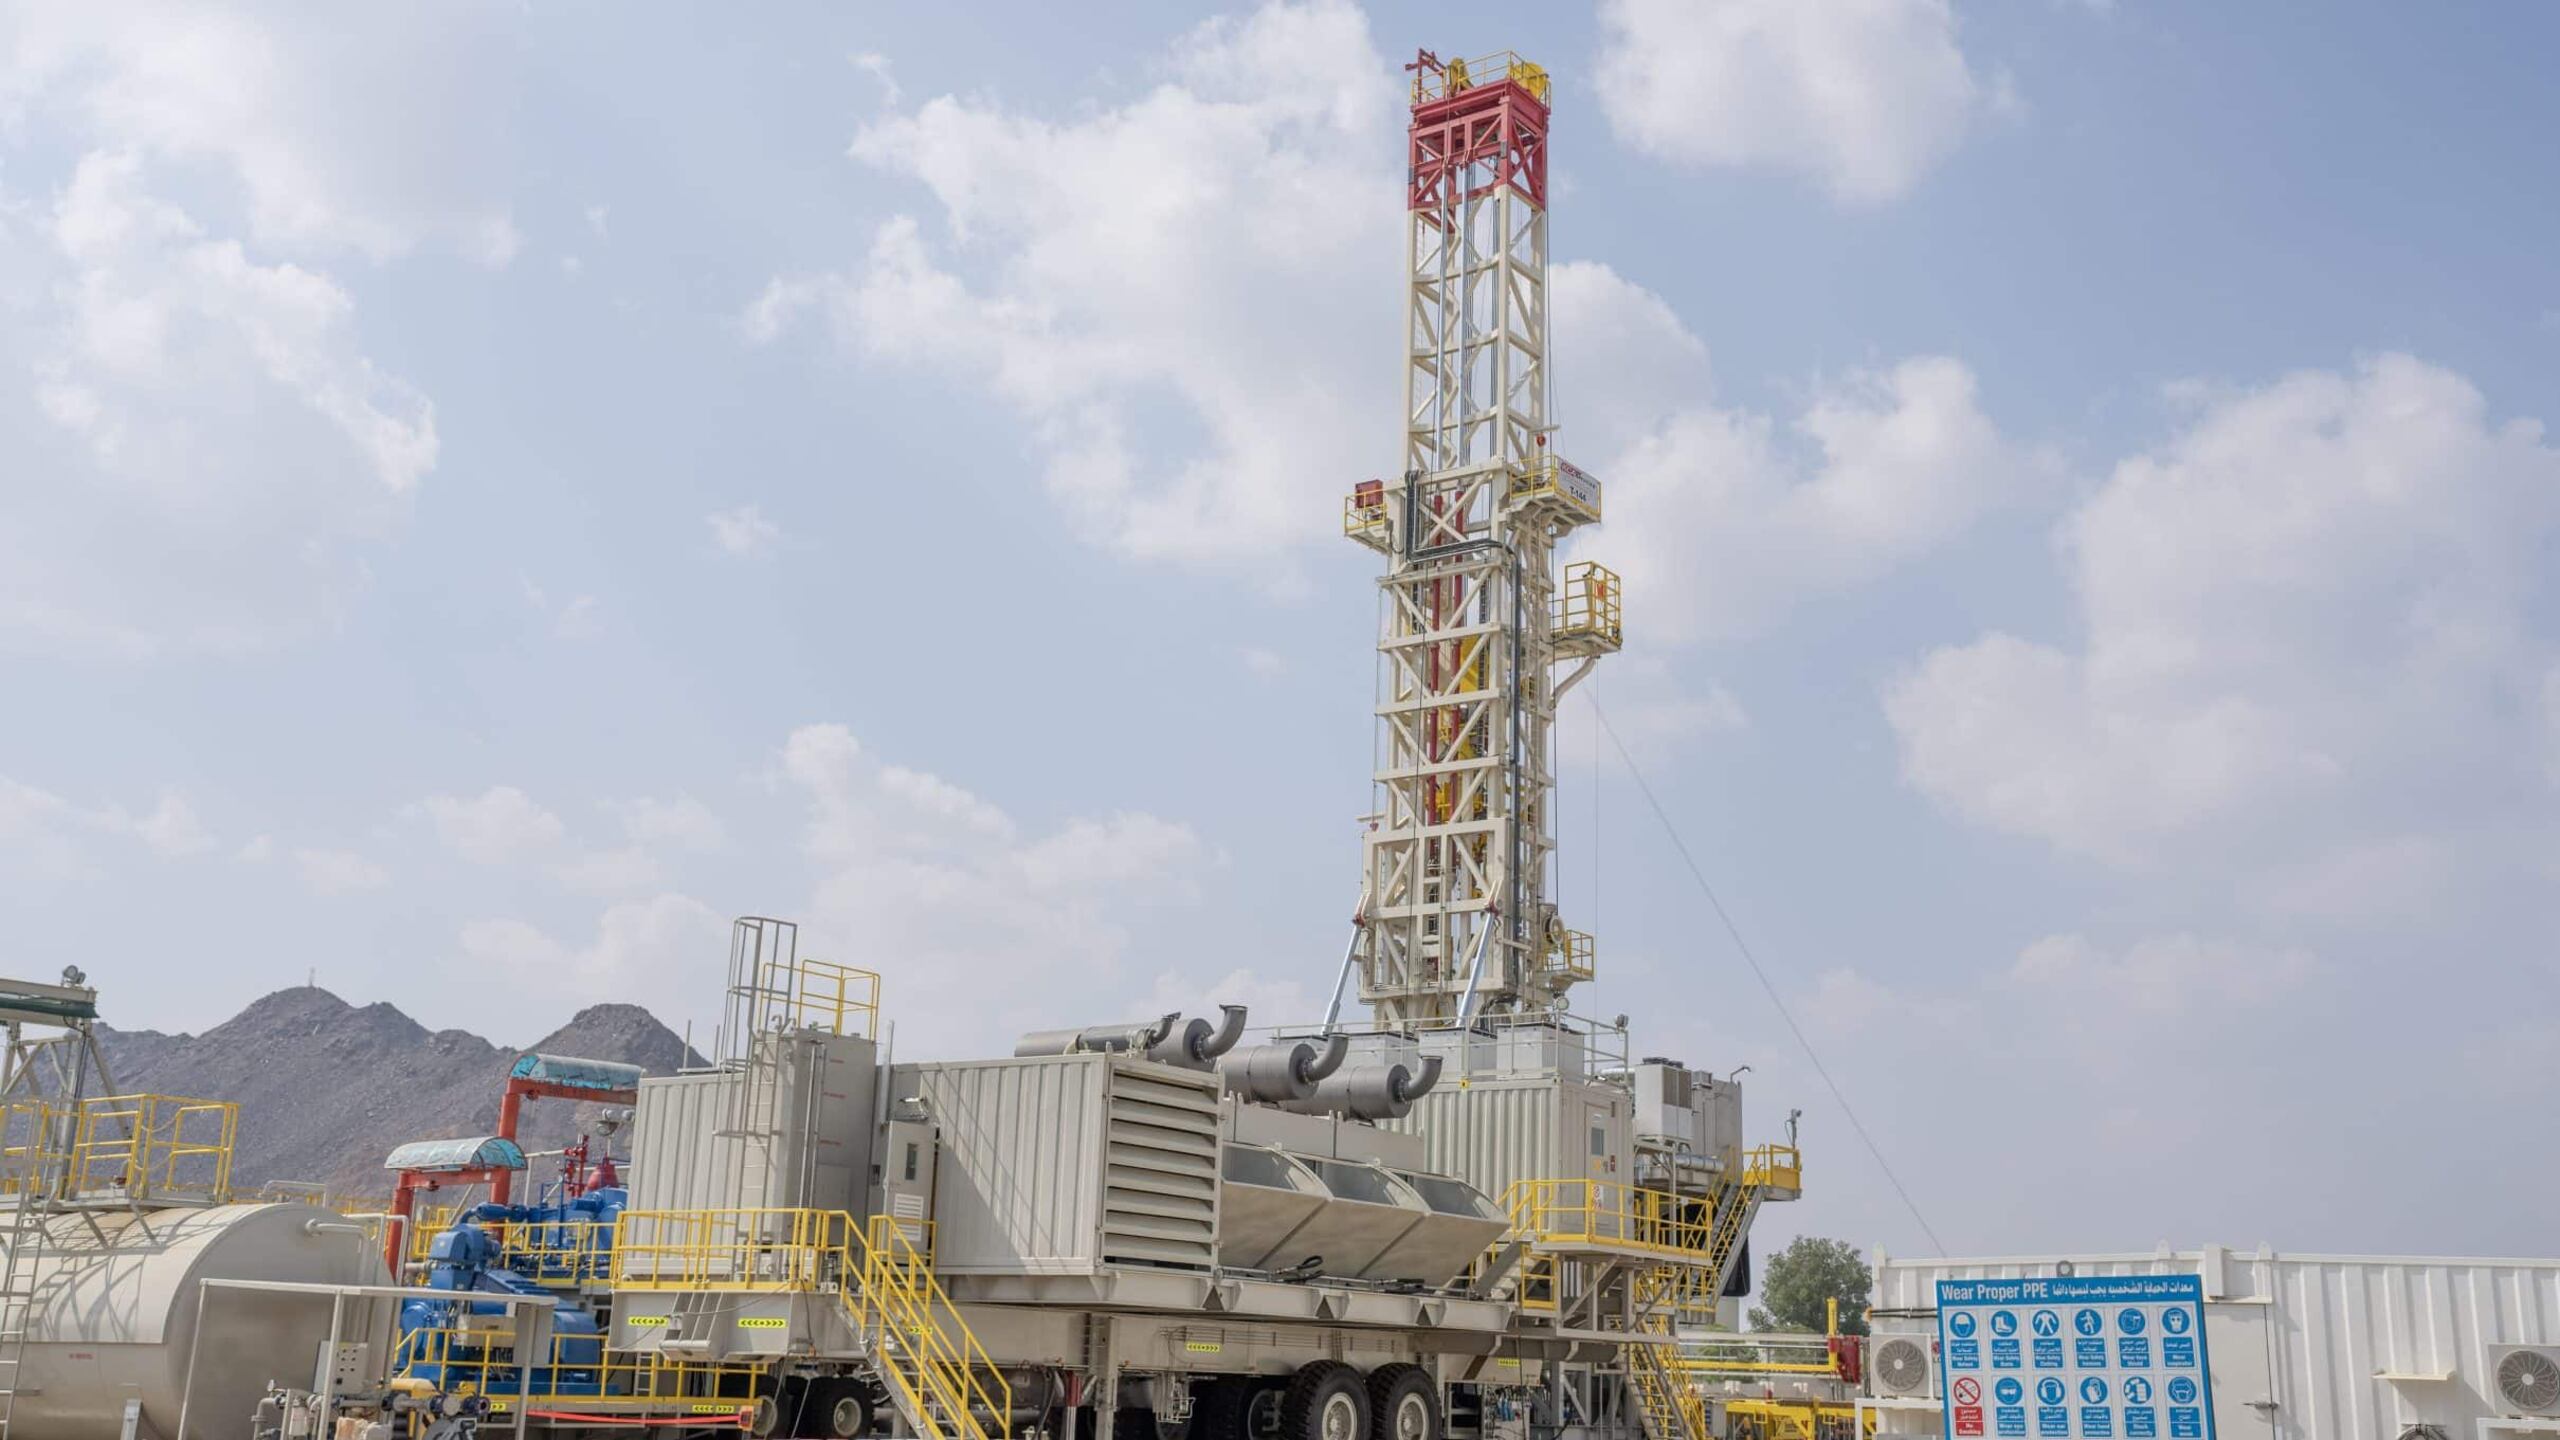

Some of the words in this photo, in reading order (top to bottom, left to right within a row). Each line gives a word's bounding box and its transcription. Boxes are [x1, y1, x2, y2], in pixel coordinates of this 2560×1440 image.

[1941, 1284, 1974, 1300] Wear
[1977, 1283, 2020, 1302] Proper
[2023, 1281, 2048, 1299] PPE
[2168, 1281, 2194, 1294] معدات
